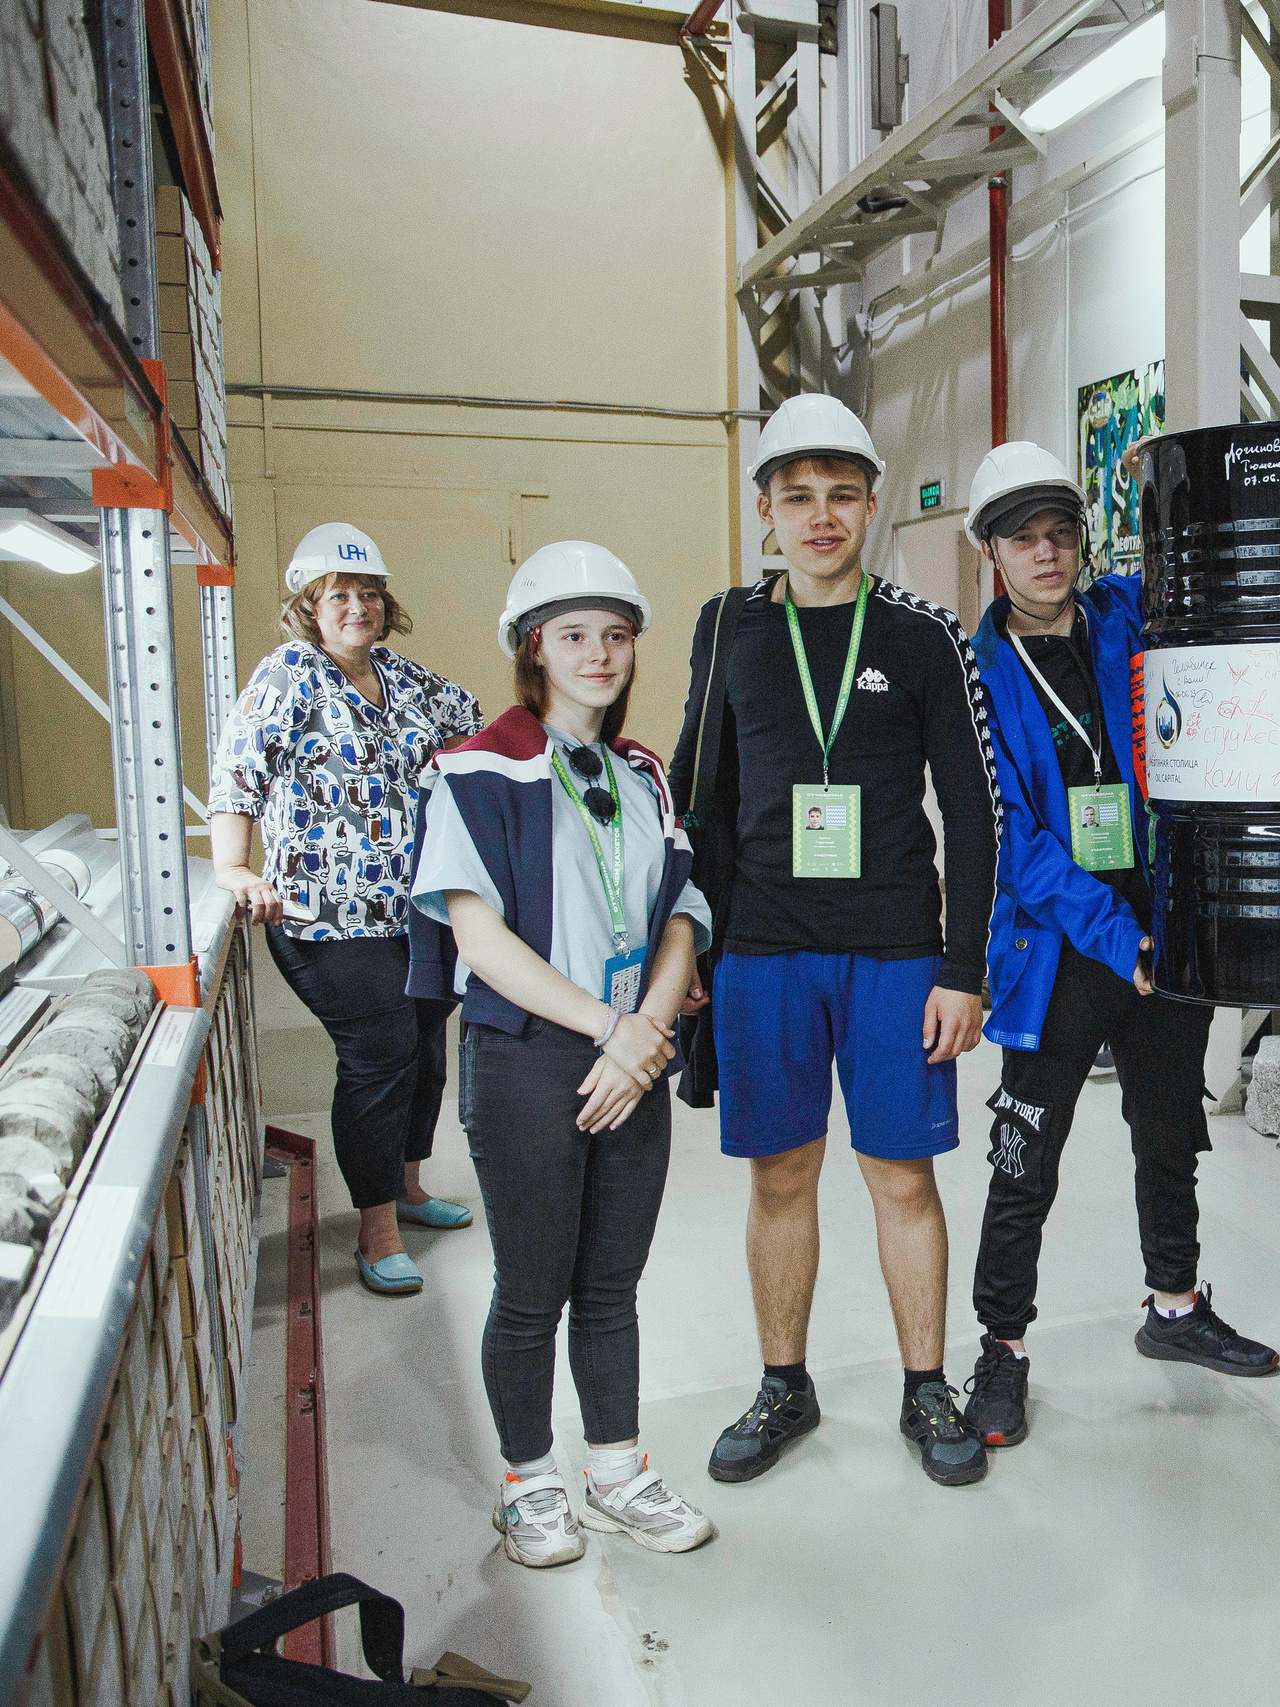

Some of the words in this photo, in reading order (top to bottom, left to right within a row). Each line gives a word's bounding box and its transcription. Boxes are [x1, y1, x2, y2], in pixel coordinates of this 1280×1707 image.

[857, 680, 889, 693] Kappa
[1169, 758, 1199, 770] СТОЛИЦА
[1161, 773, 1182, 783] CAPITAL
[613, 826, 621, 867] КАЖЕТСЯ
[994, 1087, 1014, 1110] NEW
[1013, 1099, 1046, 1132] YORK
